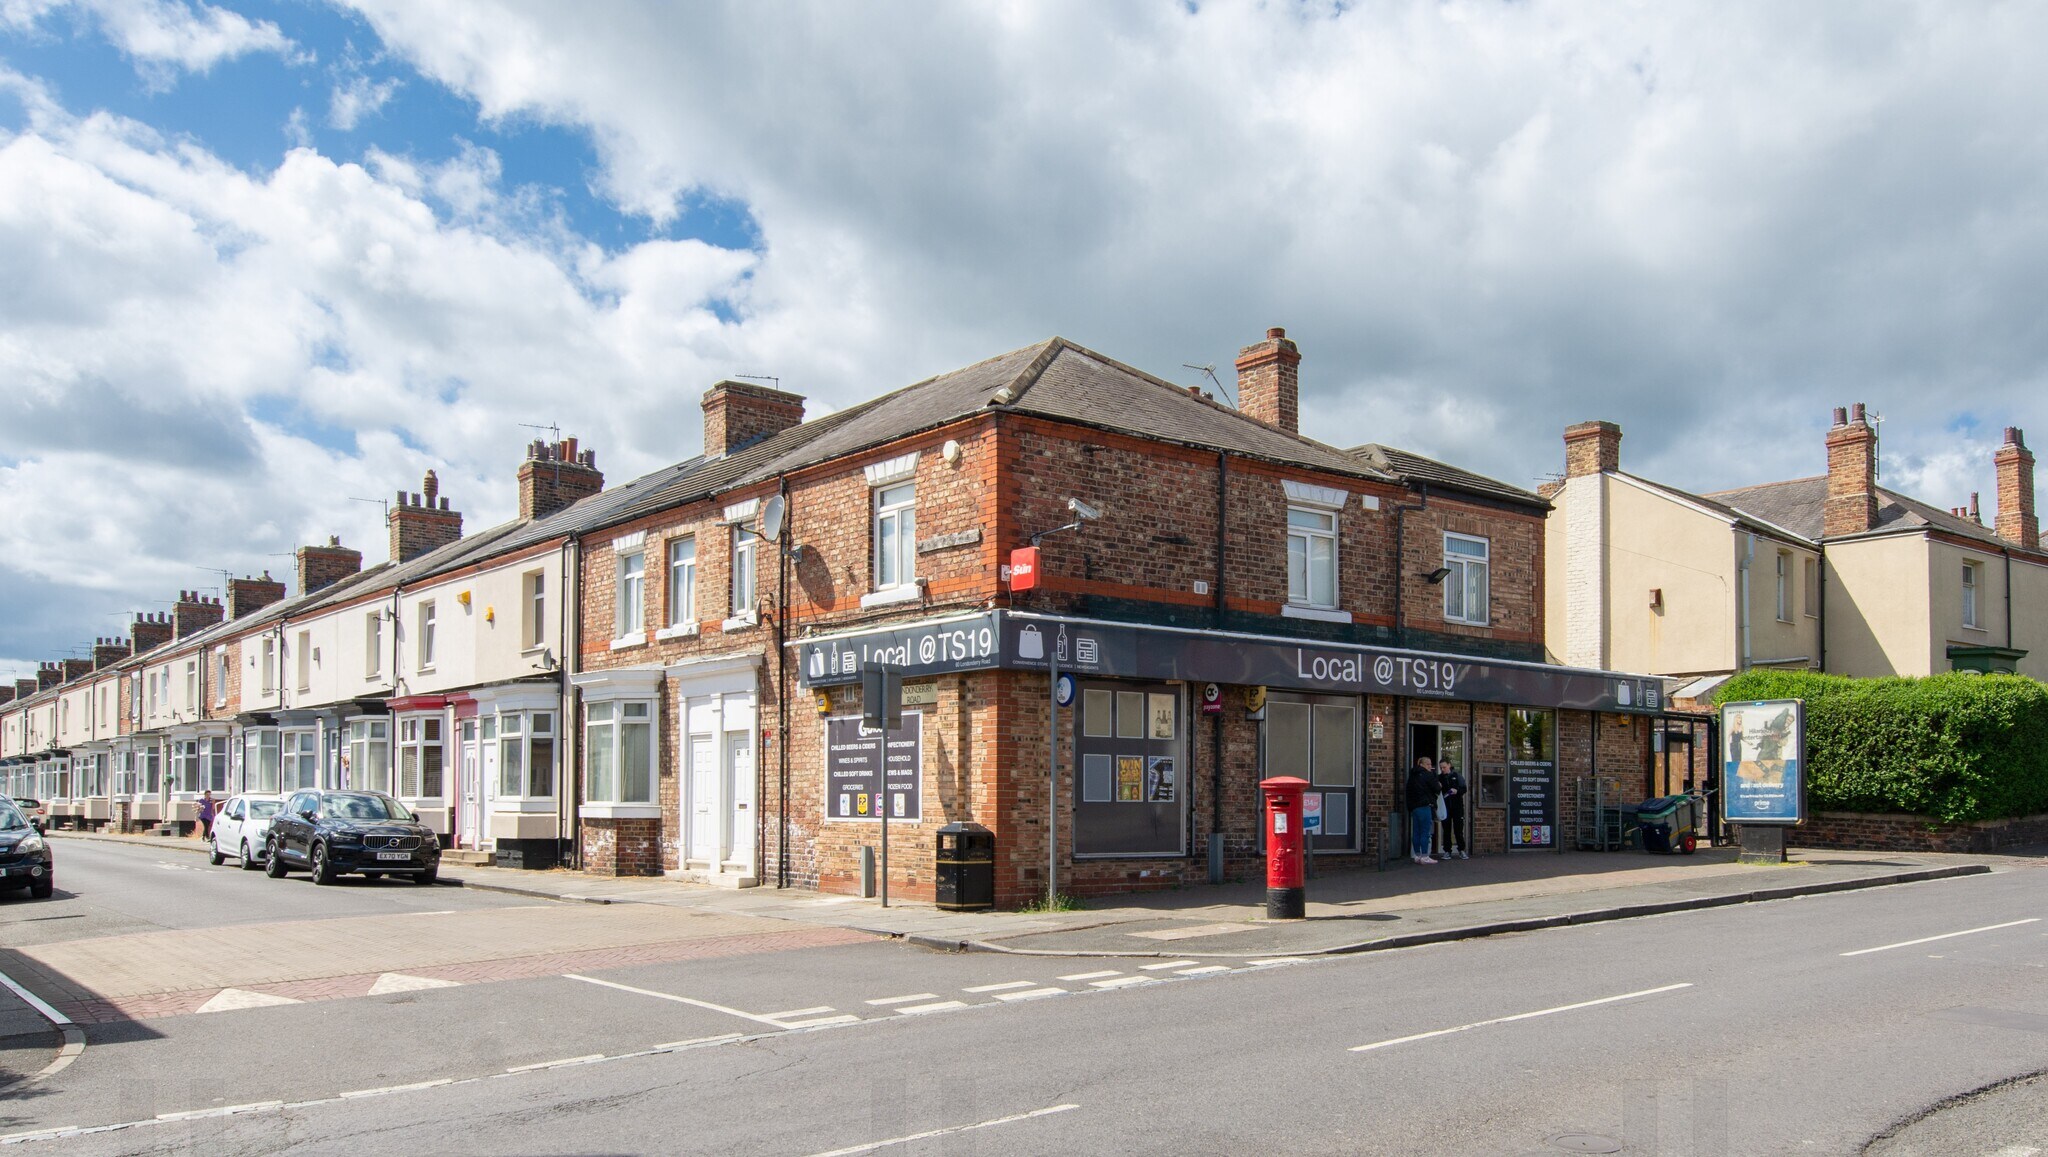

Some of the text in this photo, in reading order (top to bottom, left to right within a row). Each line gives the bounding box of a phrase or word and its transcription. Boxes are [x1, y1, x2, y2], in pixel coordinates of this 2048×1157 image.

[1013, 563, 1032, 576] Sun
[863, 627, 992, 667] Local @TS19
[960, 659, 981, 667] Londonderry
[1297, 648, 1455, 690] Local @TS19
[901, 684, 933, 695] NDONDERRY
[1120, 759, 1140, 769] WIN
